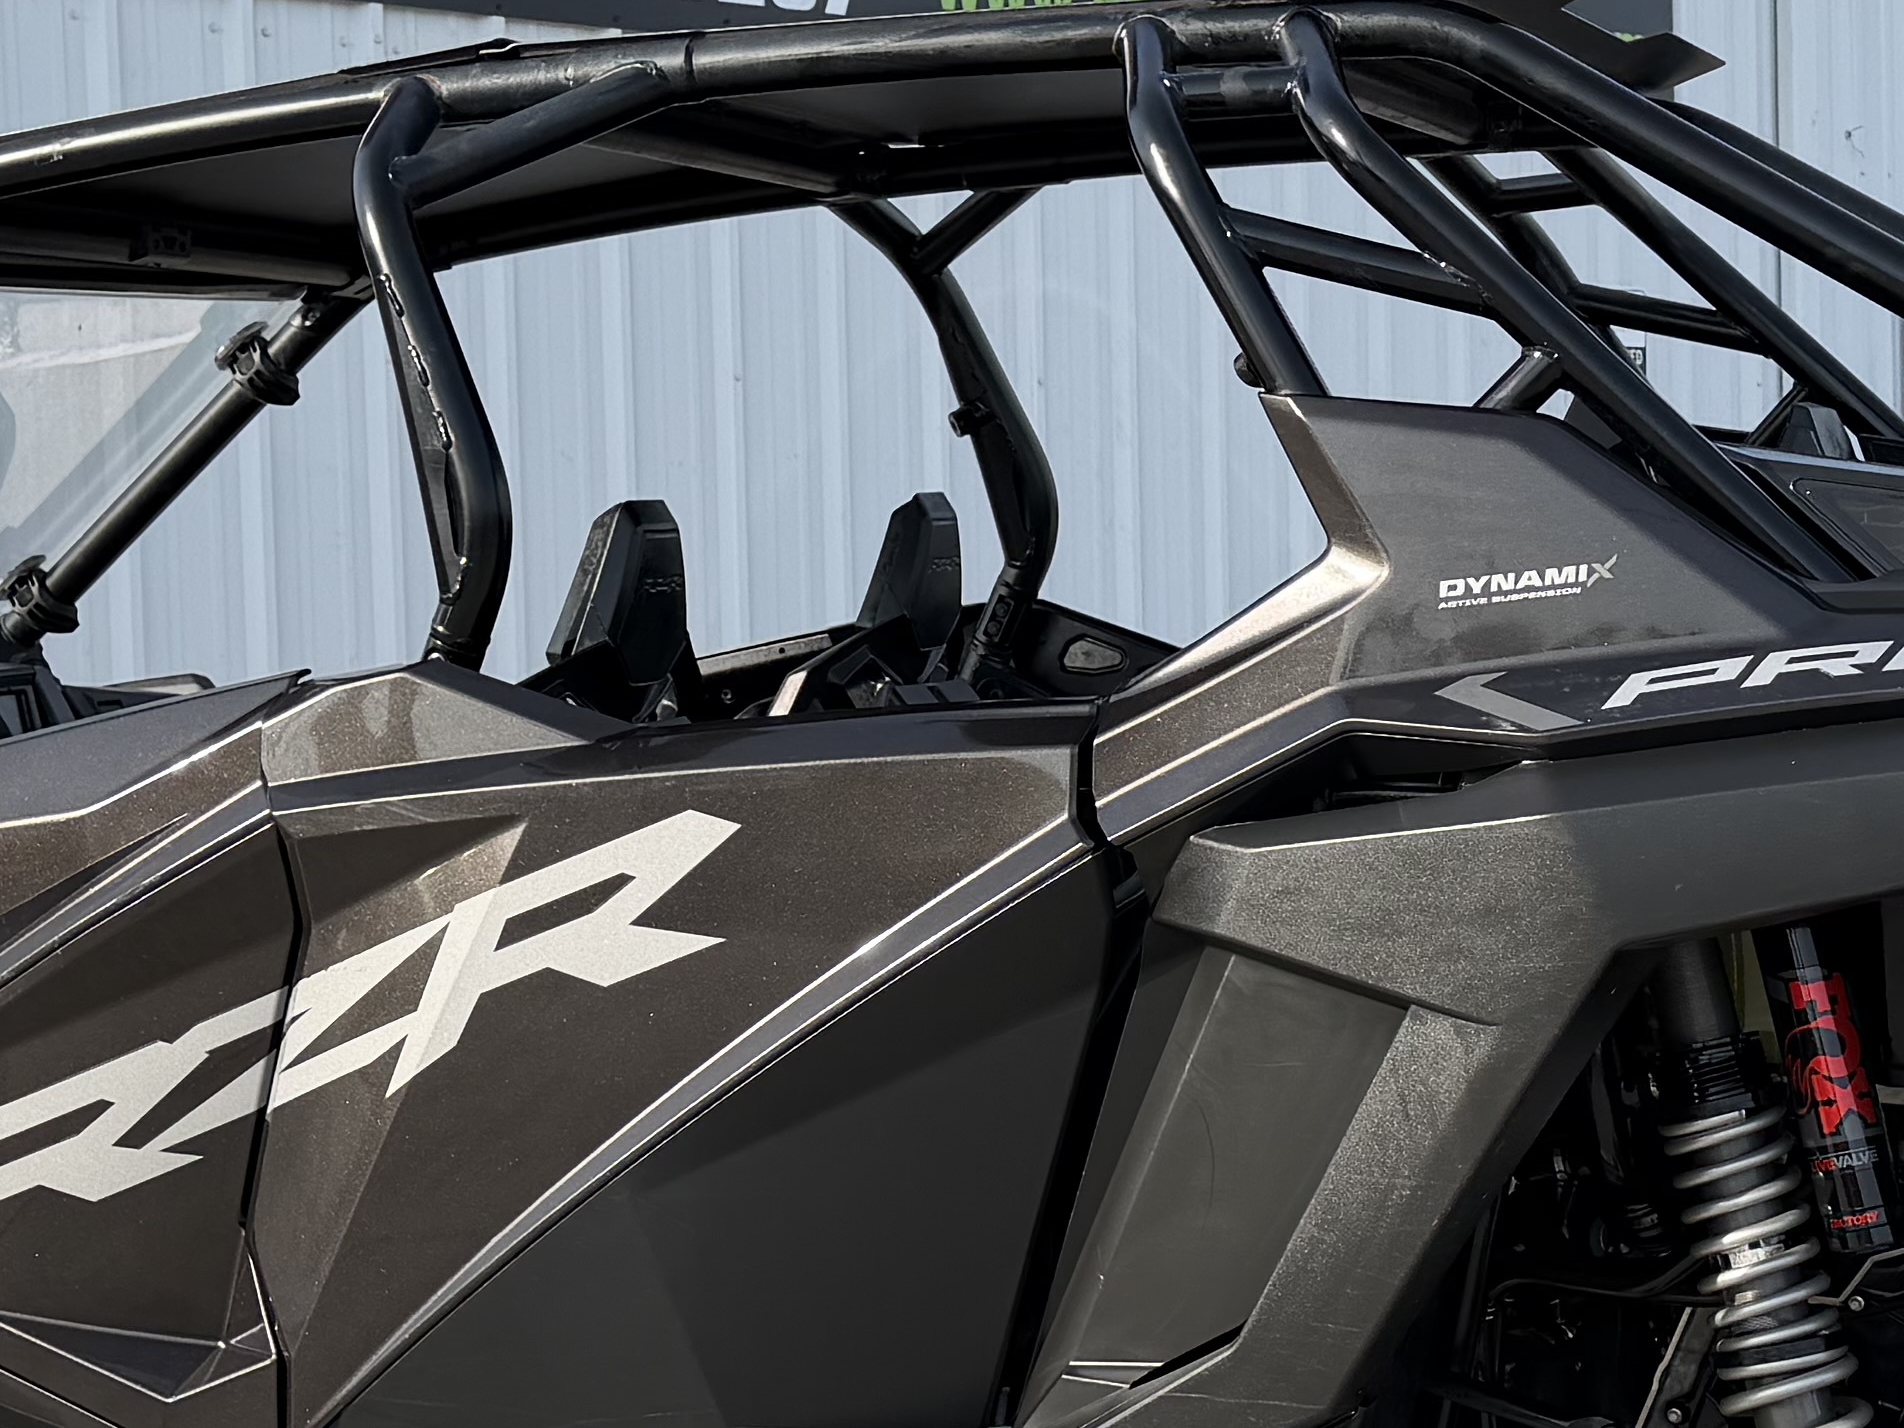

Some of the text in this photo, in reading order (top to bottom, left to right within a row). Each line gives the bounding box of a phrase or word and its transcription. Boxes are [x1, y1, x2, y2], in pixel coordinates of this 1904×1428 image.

[1439, 553, 1618, 598] DYNAMIX
[1438, 587, 1582, 610] ACTIVE SUSPENSION
[1786, 972, 1878, 1136] FOX
